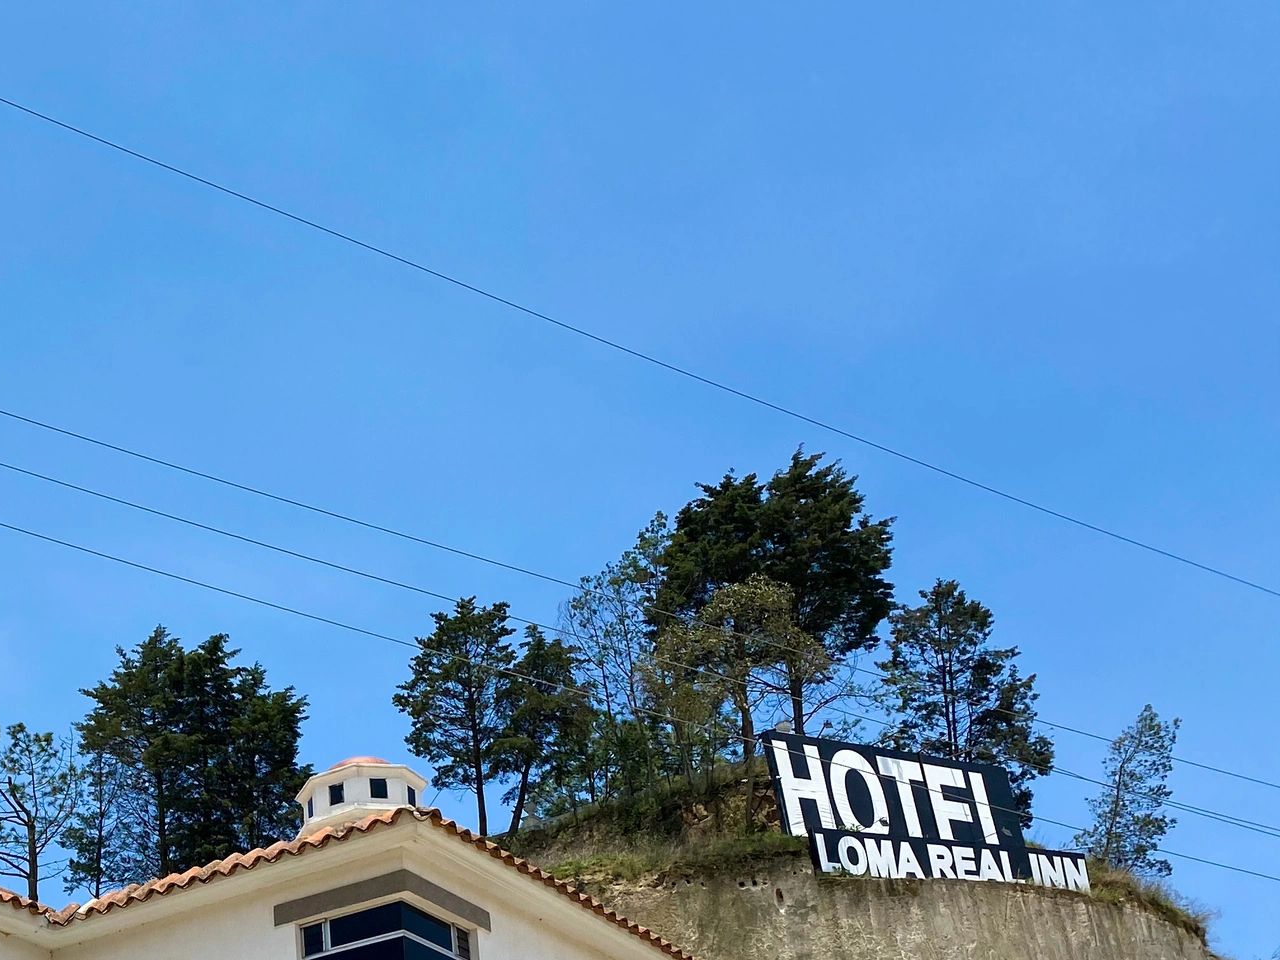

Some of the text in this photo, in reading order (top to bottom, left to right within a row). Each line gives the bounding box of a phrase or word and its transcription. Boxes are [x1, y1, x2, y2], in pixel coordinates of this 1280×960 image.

[815, 833, 1090, 893] LOMA REAL INN
